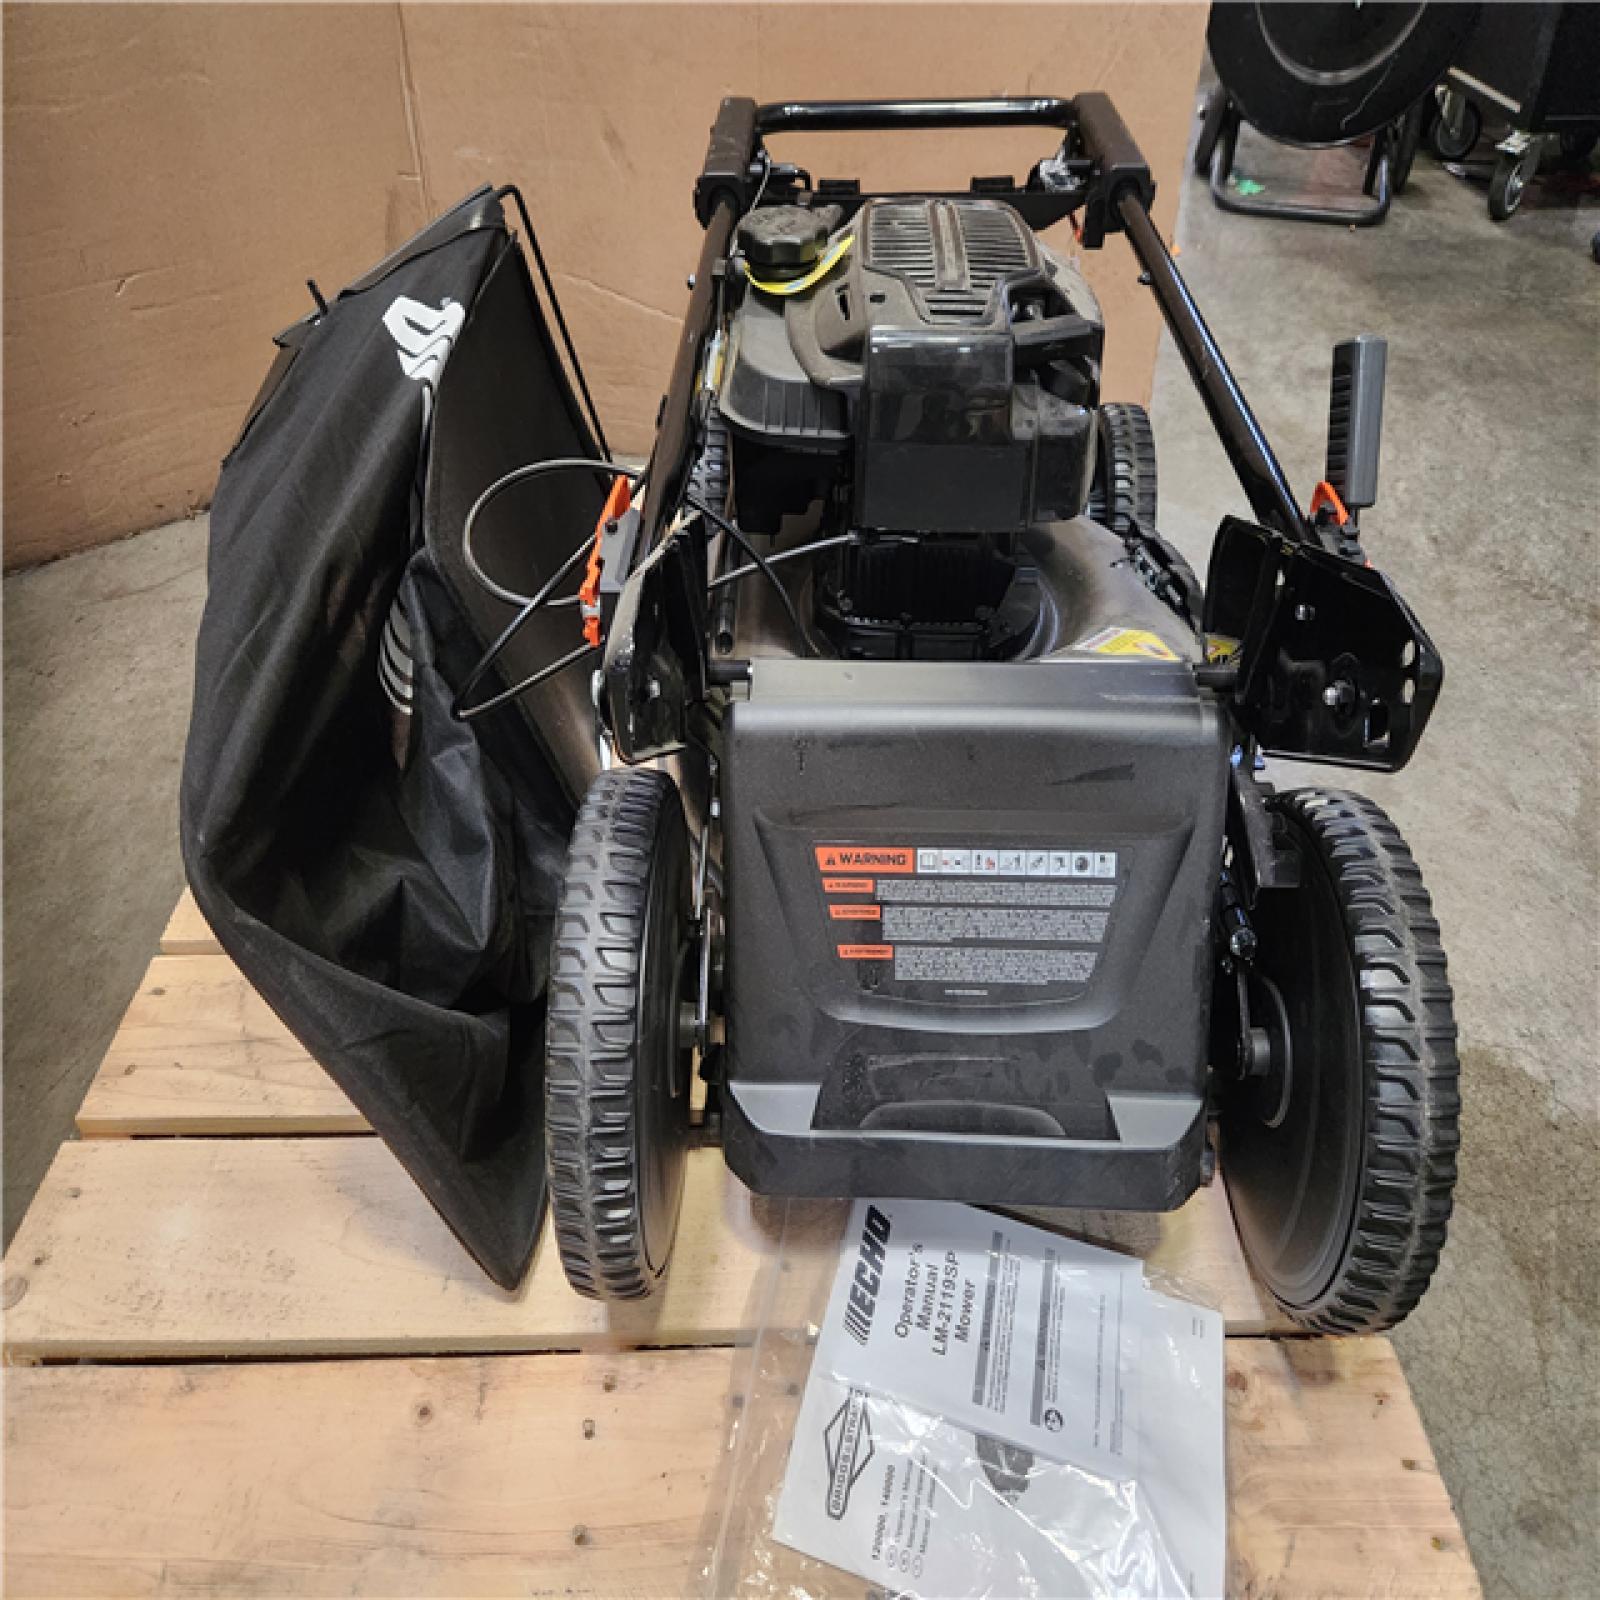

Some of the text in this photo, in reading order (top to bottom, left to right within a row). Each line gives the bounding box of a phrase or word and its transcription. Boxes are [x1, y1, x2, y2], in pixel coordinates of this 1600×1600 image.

[839, 852, 907, 866] WARNING
[850, 1204, 891, 1318] ECHO
[894, 1242, 924, 1339] Operator's
[914, 1262, 939, 1331] Manual
[932, 1250, 960, 1356] LM-2119SP
[953, 1278, 976, 1343] Mower
